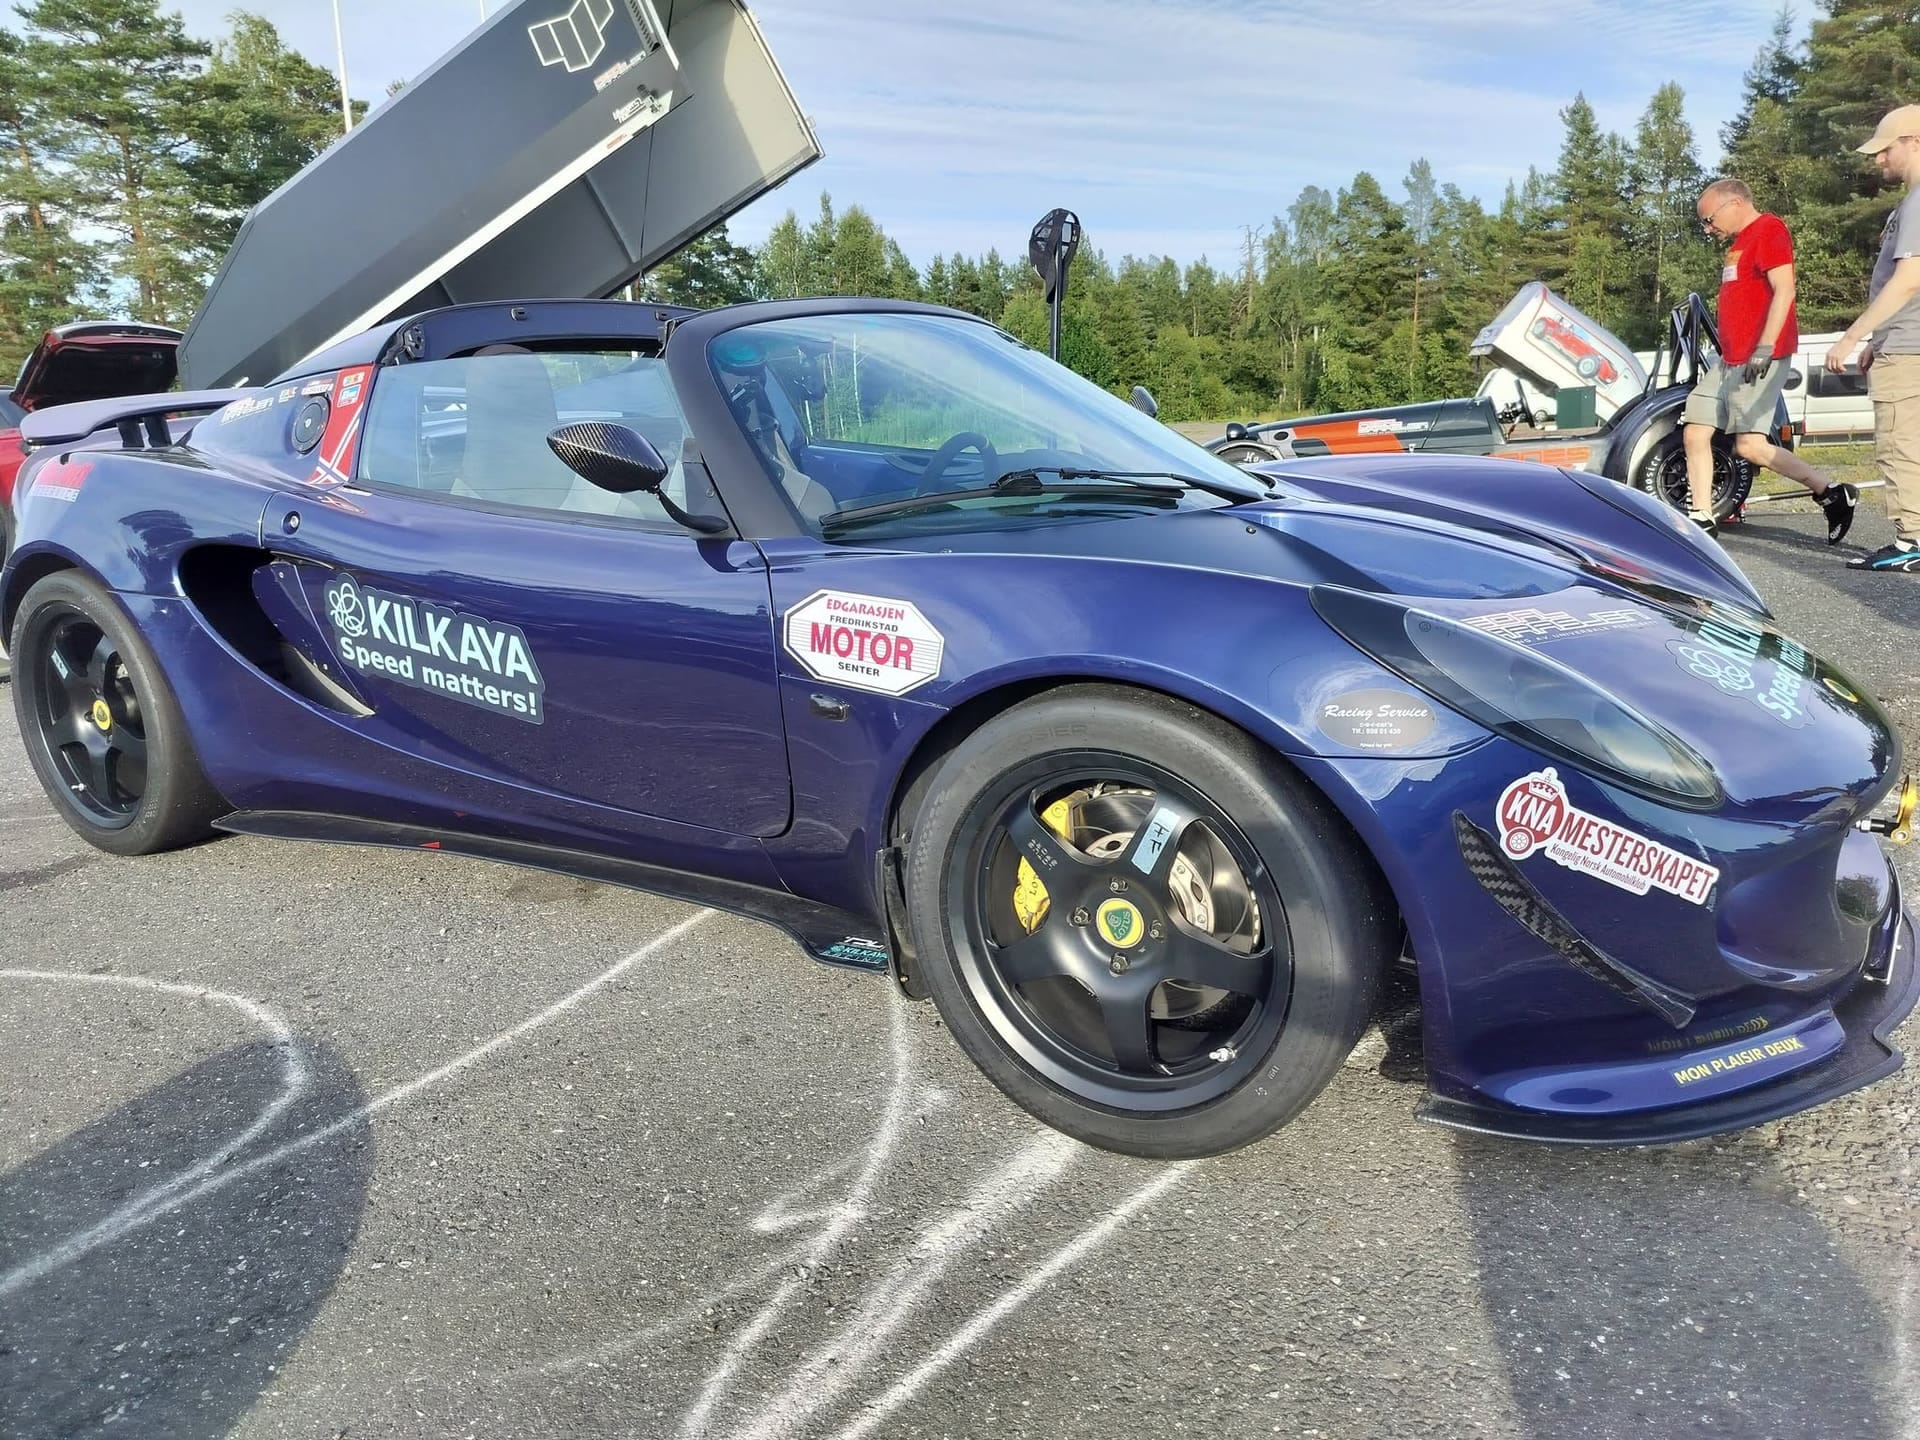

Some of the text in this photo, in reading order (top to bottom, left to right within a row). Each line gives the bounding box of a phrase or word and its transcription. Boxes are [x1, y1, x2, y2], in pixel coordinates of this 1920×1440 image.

[826, 598, 905, 621] EDGARASJEN
[829, 614, 899, 633] FREDRIKSTAD
[367, 595, 537, 685] KILKAYA
[810, 622, 914, 670] MOTOR
[340, 636, 537, 716] Speed matters!
[838, 661, 880, 677] SENTER
[1757, 657, 1803, 720] Speed
[1324, 704, 1429, 721] Racing Service
[1506, 792, 1554, 835] KNA
[1550, 842, 1647, 890] Kongelig Norsk Automobilklub
[1557, 811, 1715, 900] MESTERSKAPET
[1114, 910, 1131, 939] LOTUS
[1674, 1036, 1805, 1085] MON PLAISIR DEUX
